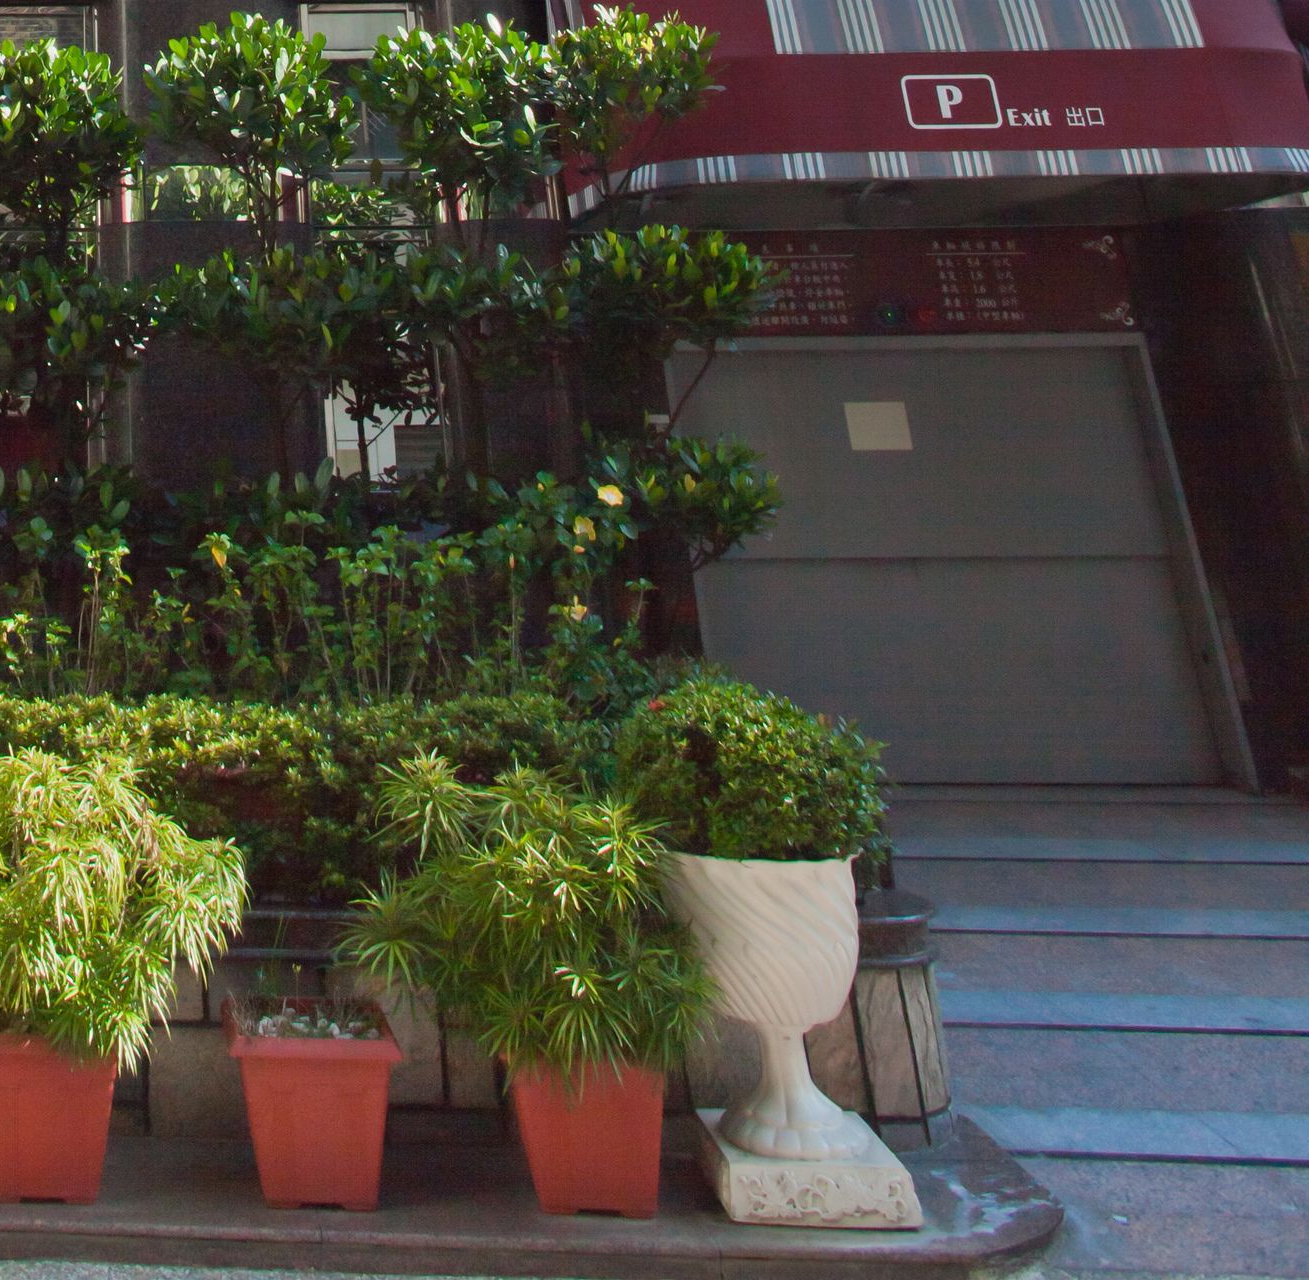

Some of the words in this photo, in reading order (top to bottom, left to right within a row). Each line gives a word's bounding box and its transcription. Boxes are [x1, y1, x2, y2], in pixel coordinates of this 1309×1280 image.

[935, 85, 963, 119] P
[1007, 108, 1052, 127] Exit
[1065, 107, 1105, 127] 出口
